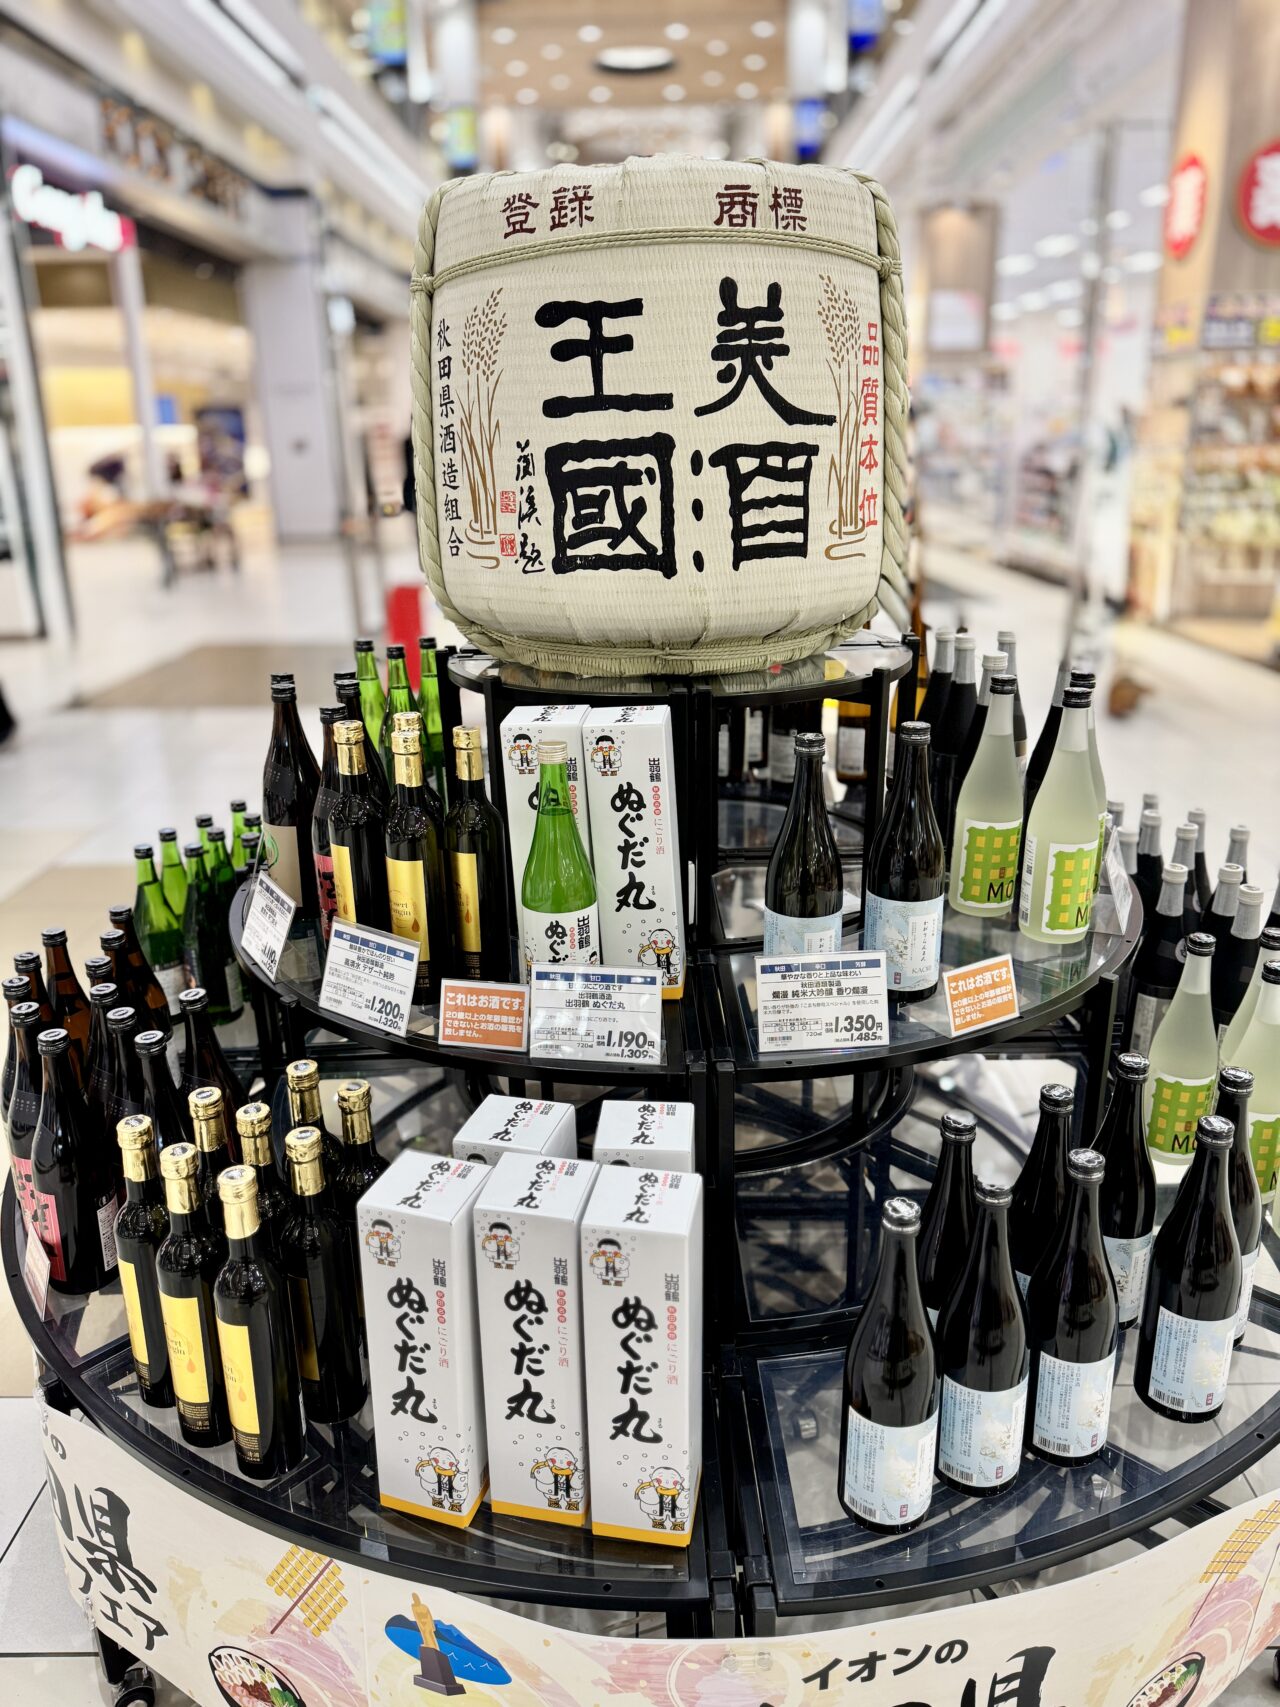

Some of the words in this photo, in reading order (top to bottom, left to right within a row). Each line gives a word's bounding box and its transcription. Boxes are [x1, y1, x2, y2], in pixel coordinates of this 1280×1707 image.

[437, 318, 465, 557] 秋田県酒造組合
[859, 321, 882, 529] 品質本位
[610, 781, 657, 913] ぬぐだ丸
[567, 982, 623, 992] 甘のにごり酒です
[780, 970, 862, 980] 華やかな香りと上品な味わい
[800, 980, 842, 989] 秋田酒類製造
[949, 967, 1011, 994] これはお酒です。
[370, 995, 405, 1022] 1,200円
[446, 992, 525, 1011] これはお酒です。
[565, 999, 590, 1008] 出羽鶴
[592, 999, 626, 1010] ぬぐだ丸
[578, 992, 613, 1001] 出羽鶴酒造
[791, 988, 833, 999] 純米大吟醸
[445, 1020, 523, 1033] できないとお酒の販売を
[606, 1029, 655, 1049] 1,190円
[835, 1014, 883, 1033] 1,350円
[488, 1101, 533, 1142] ぬぐだ丸
[630, 1104, 657, 1144] ぬぐだ丸
[396, 1161, 451, 1209] ぬぐだ丸
[513, 1160, 556, 1209] ぬぐだ丸
[622, 1172, 659, 1224] ぬぐだ丸
[387, 1277, 439, 1424] ぬぐだ丸
[504, 1279, 556, 1424] ぬぐだ丸
[610, 1296, 664, 1444] ぬぐだ丸
[802, 1639, 969, 1691] イオンの
